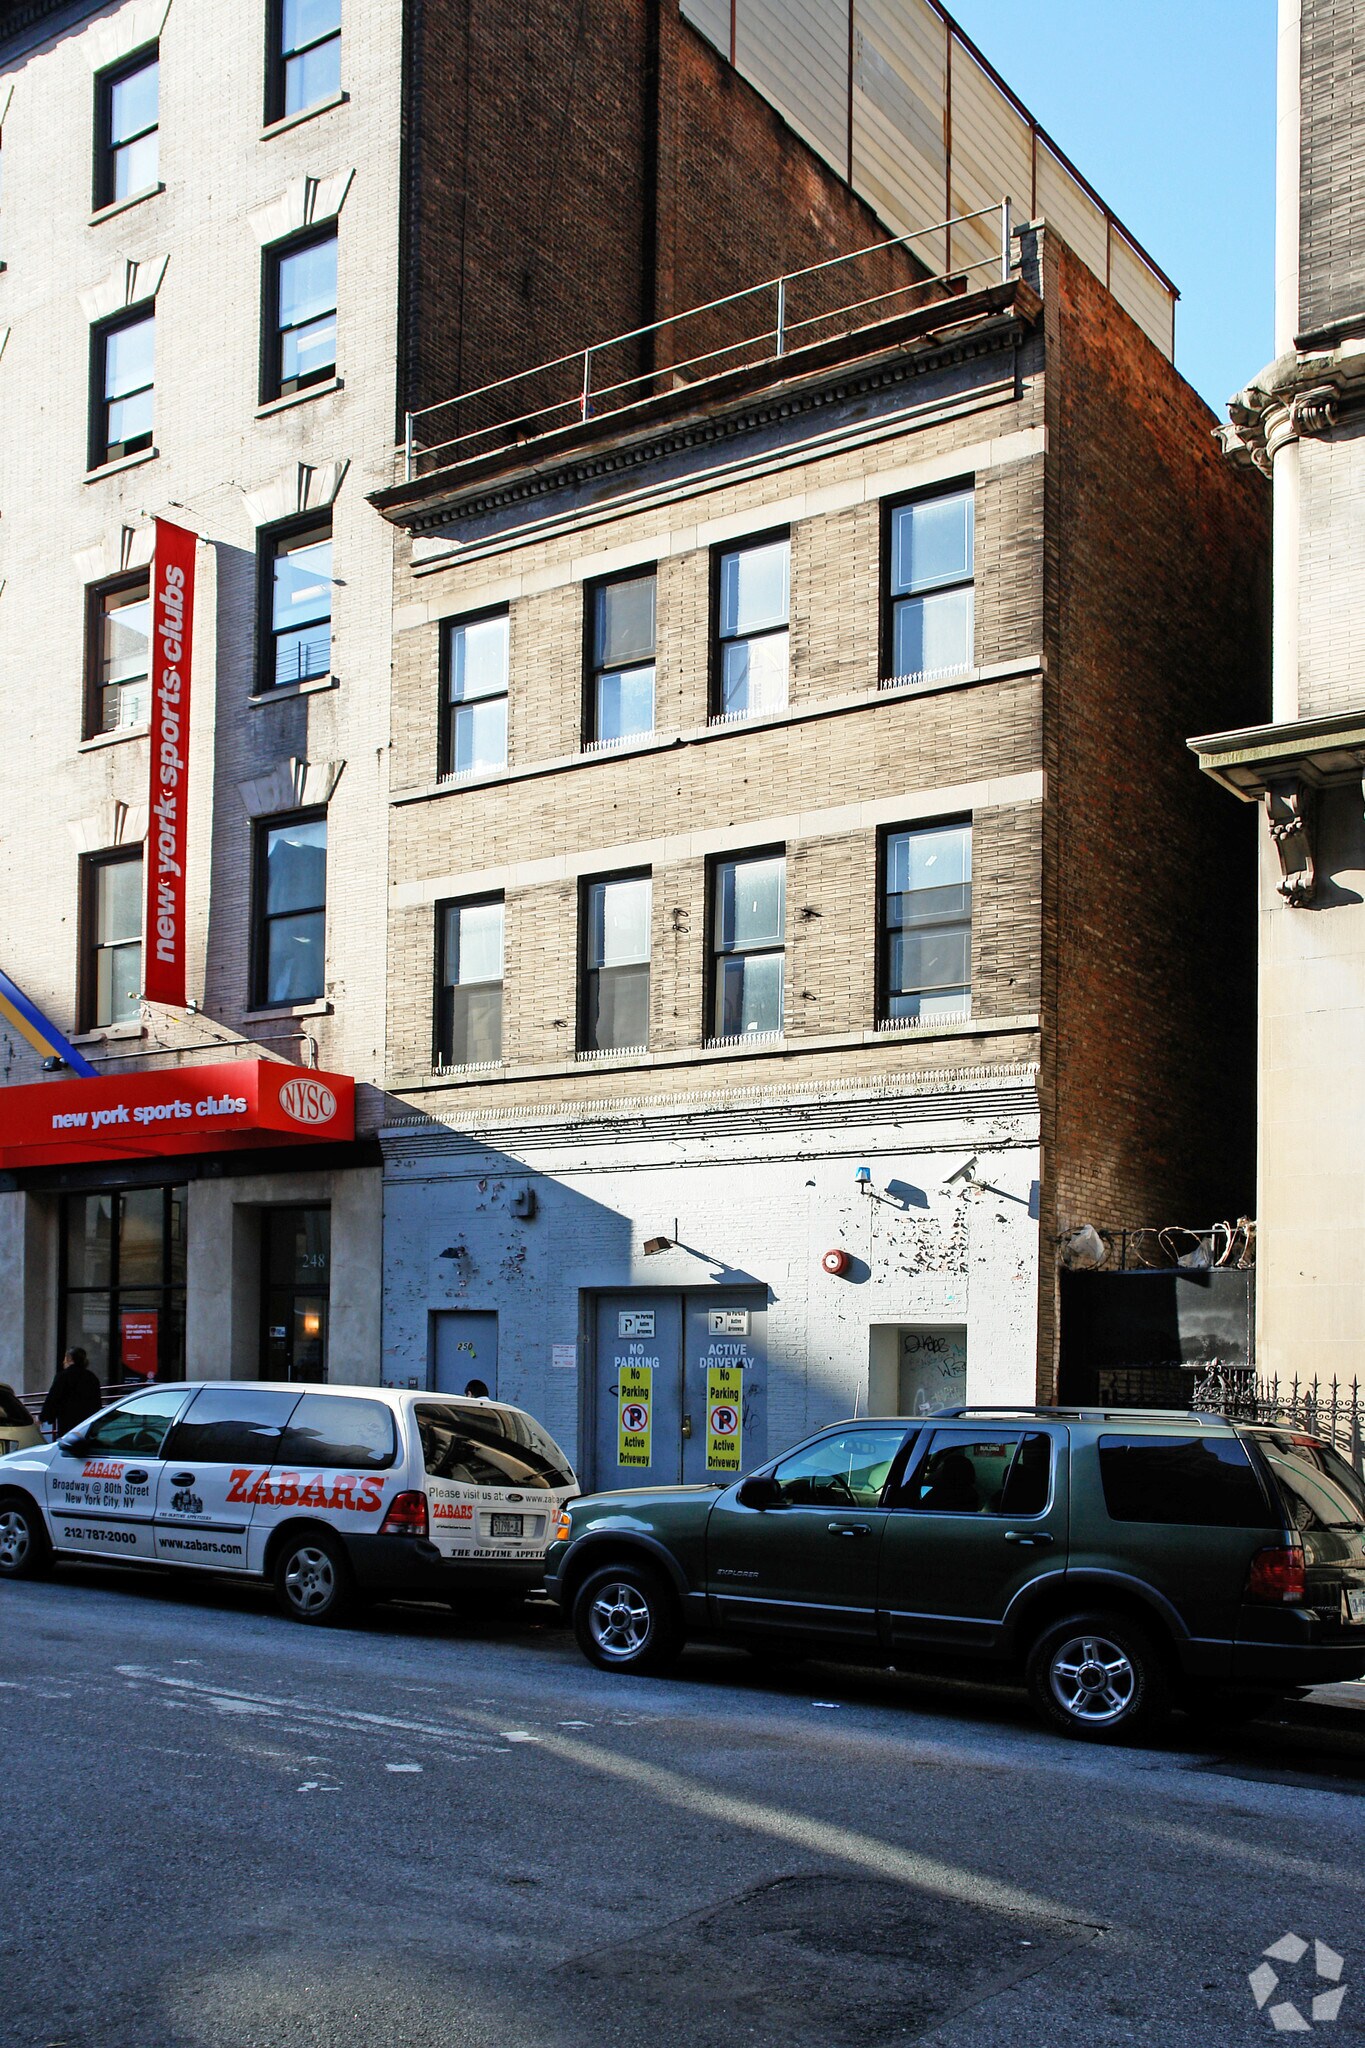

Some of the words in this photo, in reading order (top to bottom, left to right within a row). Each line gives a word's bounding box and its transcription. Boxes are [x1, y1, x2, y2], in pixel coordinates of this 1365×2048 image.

[161, 564, 185, 662] clubs
[158, 669, 184, 788] sports
[153, 793, 181, 877] york
[156, 882, 176, 963] new
[284, 1082, 332, 1120] NYSC
[52, 1111, 87, 1129] new
[91, 1104, 130, 1130] york
[133, 1099, 192, 1124] sports
[195, 1094, 248, 1116] clubs
[302, 1254, 325, 1268] 248
[457, 1342, 473, 1351] 250
[630, 1344, 644, 1354] NO
[708, 1344, 747, 1355] ACTIVE
[614, 1357, 659, 1368] PARKING
[700, 1358, 754, 1369] DRIVEWAY
[631, 1368, 640, 1380] No
[720, 1369, 730, 1381] No
[622, 1385, 649, 1400] Parking
[710, 1387, 739, 1402] Parking
[624, 1436, 645, 1448] Active
[713, 1439, 735, 1451] Active
[619, 1453, 650, 1466] Driveway
[708, 1456, 740, 1471] Driveway
[53, 1478, 90, 1495] Broadway
[92, 1482, 102, 1494] @
[104, 1482, 122, 1494] 80th
[125, 1484, 150, 1497] Street
[429, 1487, 460, 1499] Please
[463, 1489, 480, 1500] visit
[482, 1492, 491, 1500] us
[494, 1491, 504, 1501] at:
[65, 1493, 82, 1504] New
[84, 1494, 101, 1506] York
[103, 1496, 121, 1509] City,
[123, 1497, 135, 1508] NY
[64, 1527, 136, 1544] 212/787-2000
[159, 1537, 242, 1555] www.zabars.com
[451, 1549, 470, 1557] THE
[474, 1550, 512, 1558] OLDTIME
[716, 1568, 759, 1578] EXPLORER
